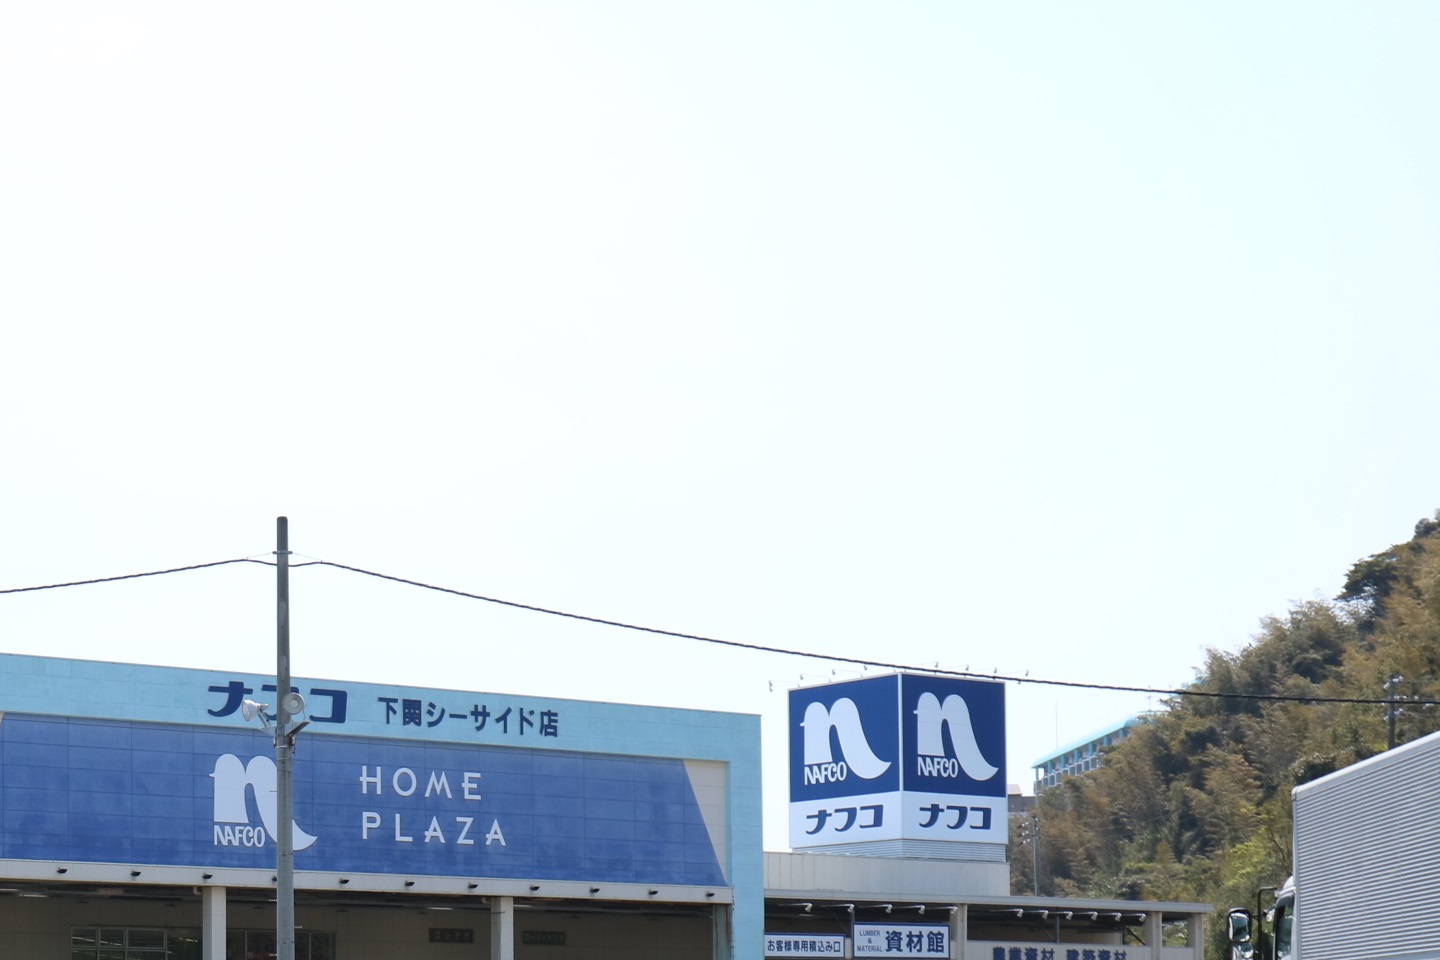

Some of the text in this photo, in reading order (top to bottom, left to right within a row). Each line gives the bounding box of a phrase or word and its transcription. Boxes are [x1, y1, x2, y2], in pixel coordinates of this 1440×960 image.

[378, 697, 559, 738] 下関シーサイド店
[804, 761, 847, 785] NAFCO
[917, 756, 958, 779] NAFCO
[359, 765, 482, 801] HOME
[362, 811, 507, 847] PLAZA
[805, 804, 884, 835] ナフコ
[918, 803, 992, 830] ナフコ
[213, 824, 266, 848] NAFCO
[767, 940, 841, 953] お客様専用積込み口
[885, 930, 945, 953] 資材館
